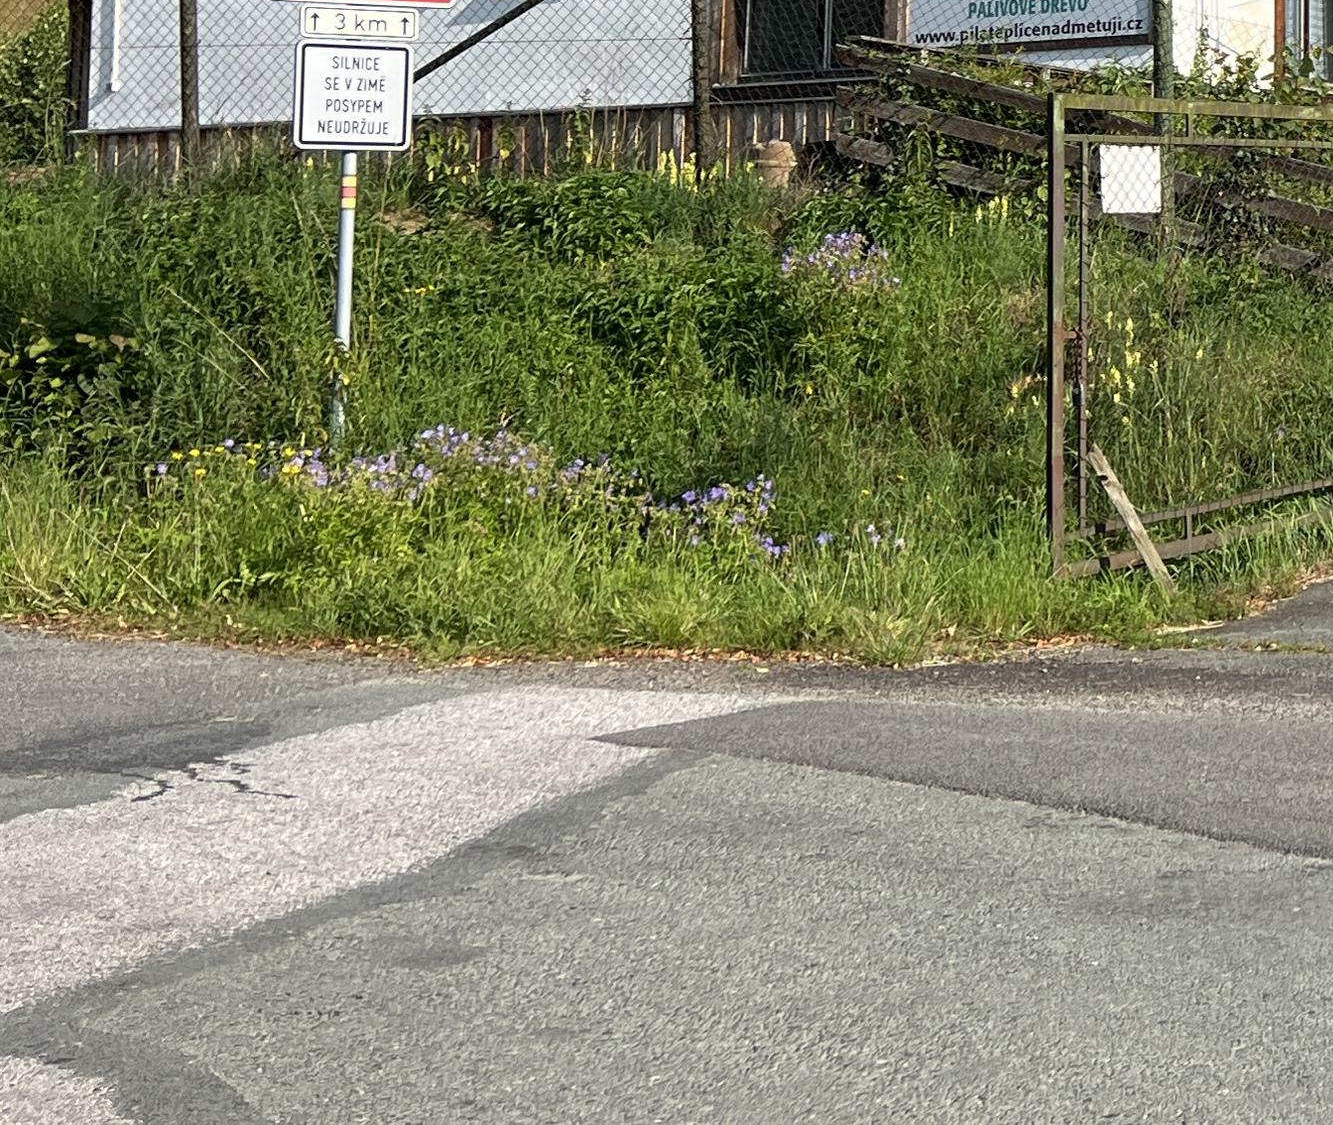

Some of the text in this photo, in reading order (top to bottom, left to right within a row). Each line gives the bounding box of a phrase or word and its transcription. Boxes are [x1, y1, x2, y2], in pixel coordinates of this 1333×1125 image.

[335, 13, 387, 32] 3 km
[332, 55, 381, 71] SILNICE
[324, 75, 386, 92] SE V ZIMĚ
[325, 98, 384, 114] POSYPEM
[317, 118, 390, 136] NEUDRŽUJE
